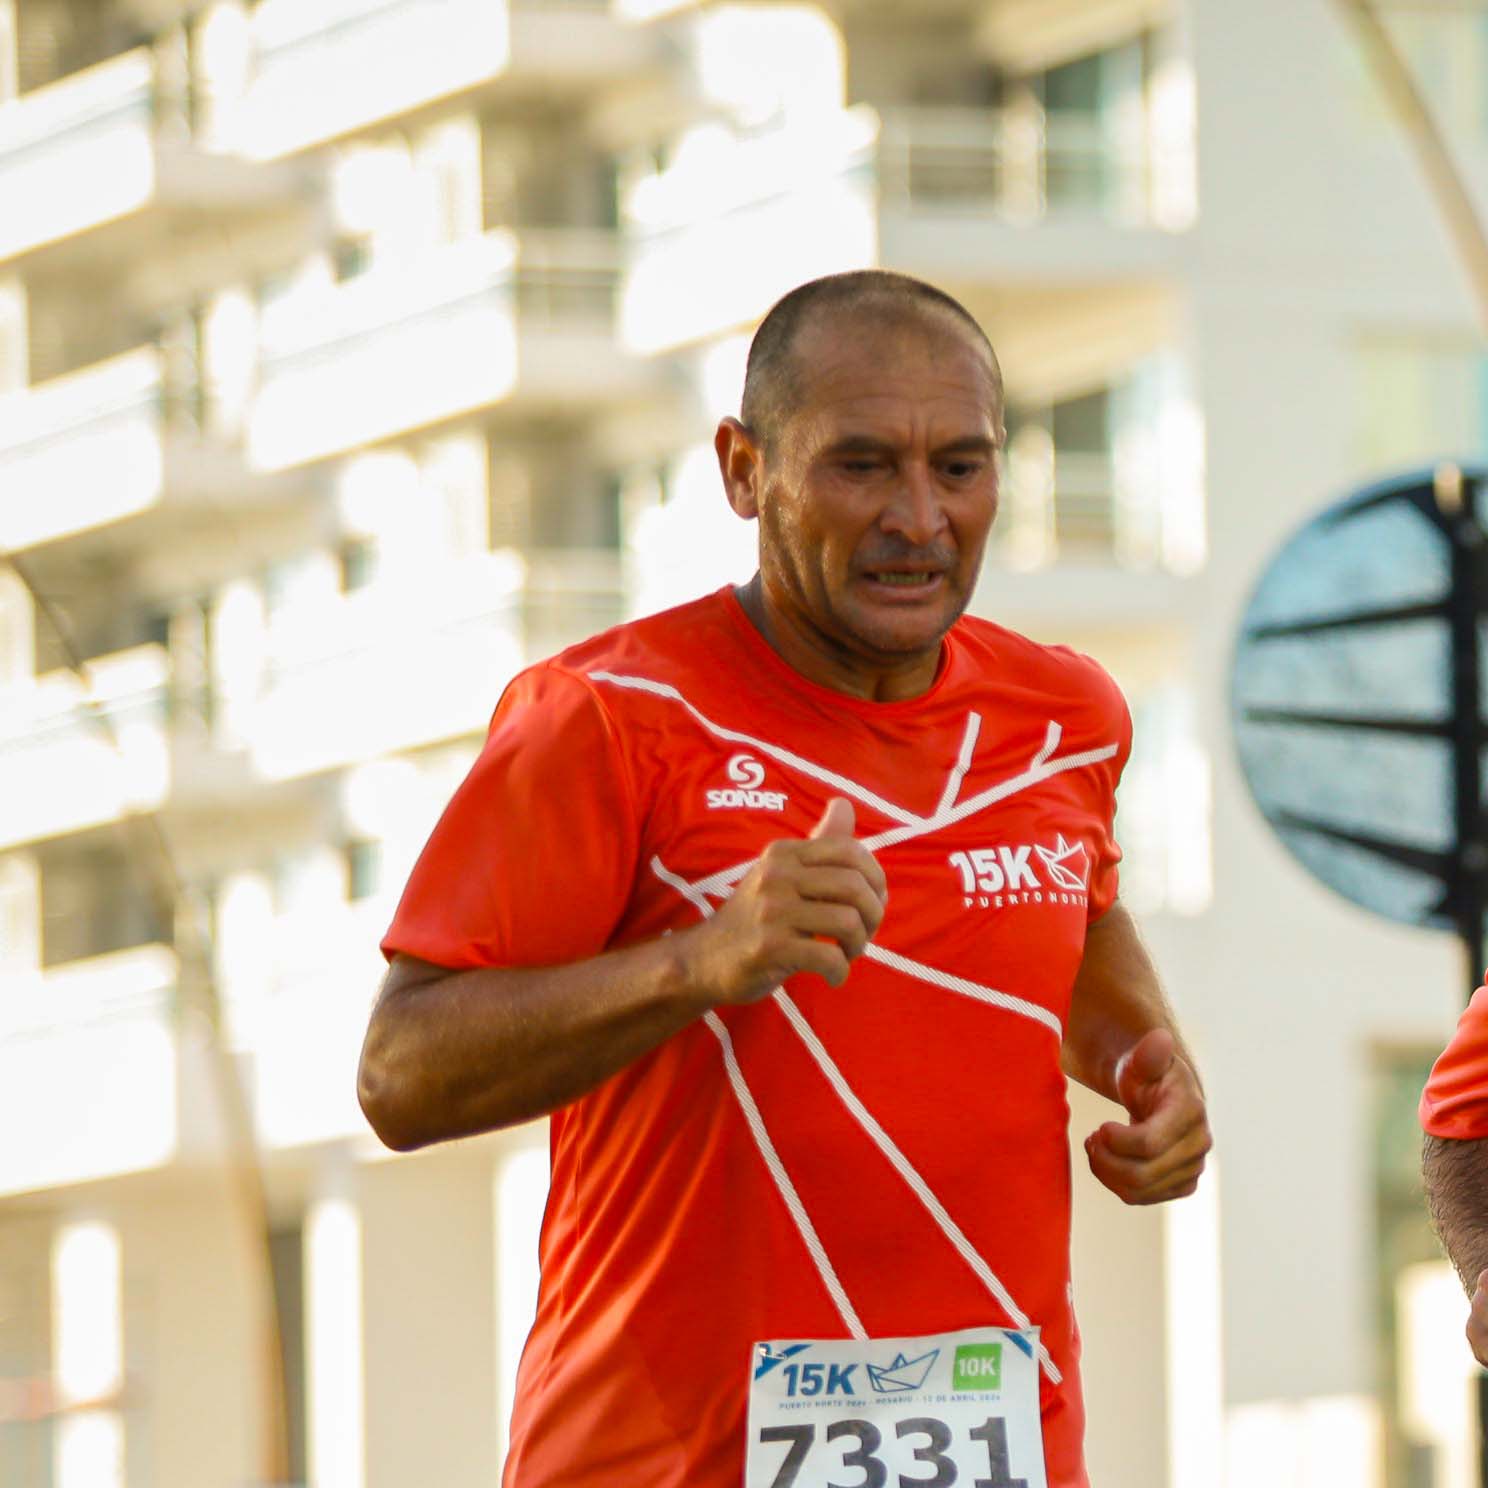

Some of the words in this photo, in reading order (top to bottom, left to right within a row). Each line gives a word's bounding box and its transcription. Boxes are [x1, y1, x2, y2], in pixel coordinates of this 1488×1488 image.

[949, 845, 1041, 893] 15K
[964, 891, 1043, 909] PUERTO
[783, 1363, 859, 1397] 15K
[958, 1357, 997, 1377] 10K
